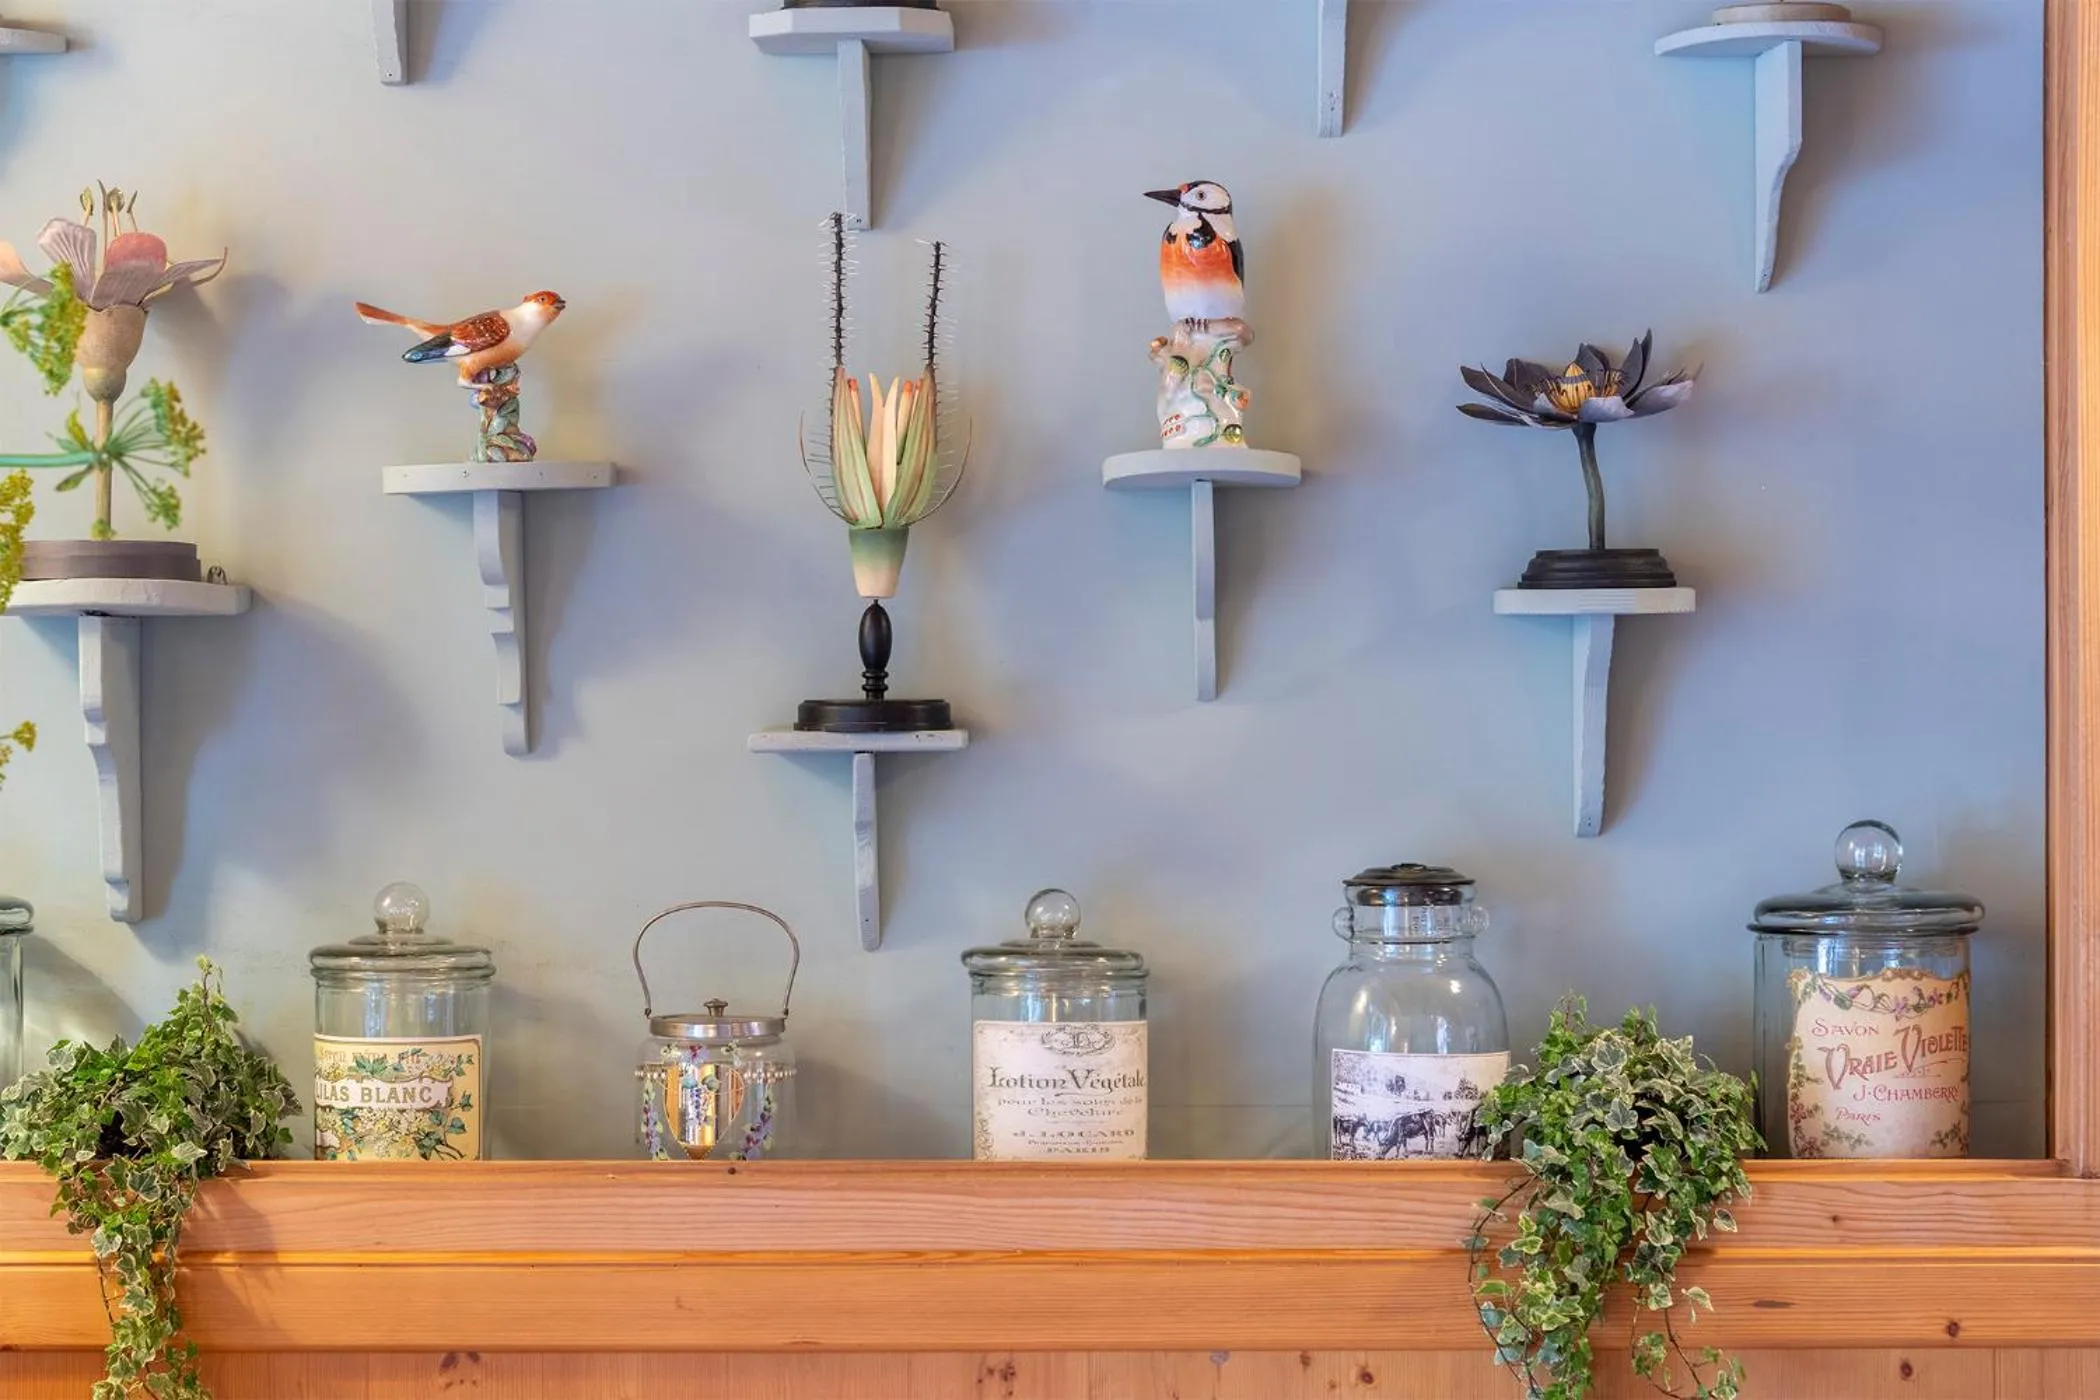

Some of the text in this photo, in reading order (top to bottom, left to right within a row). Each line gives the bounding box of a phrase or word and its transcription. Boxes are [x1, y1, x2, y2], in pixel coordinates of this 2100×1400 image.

[1811, 1017, 1880, 1036] SAVON
[1817, 1043, 1898, 1091] VRAIE
[987, 1066, 1066, 1090] Lotion
[361, 1086, 433, 1103] BLANC
